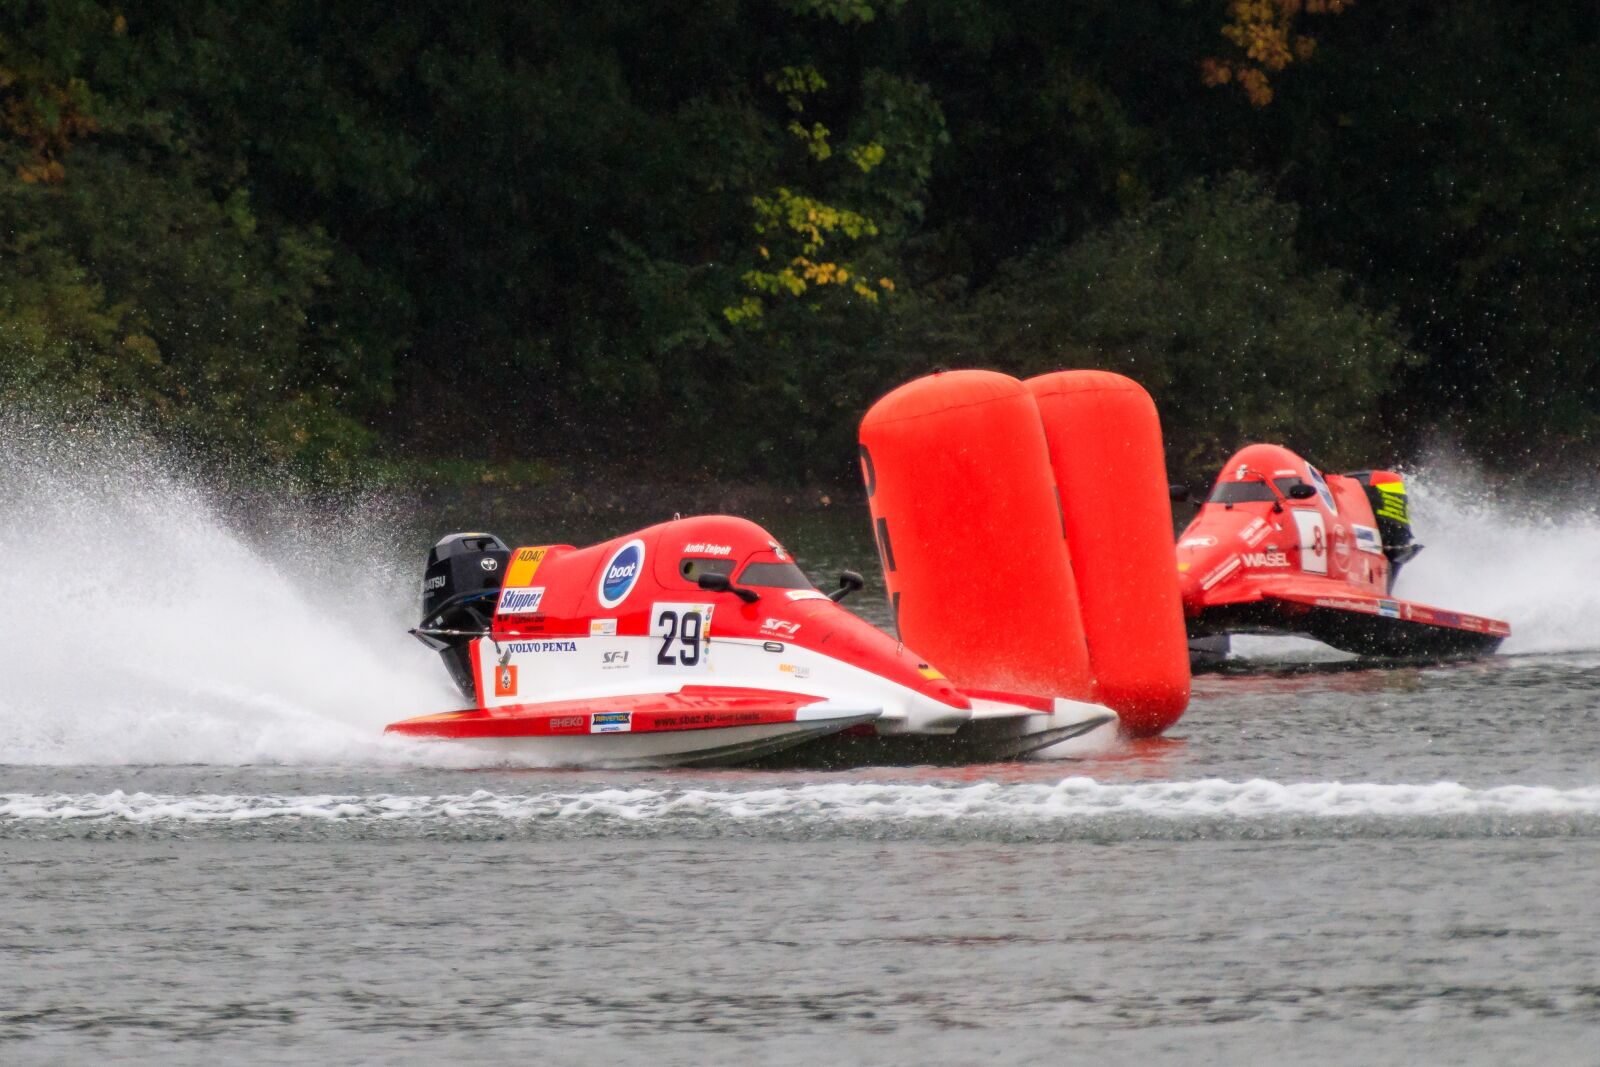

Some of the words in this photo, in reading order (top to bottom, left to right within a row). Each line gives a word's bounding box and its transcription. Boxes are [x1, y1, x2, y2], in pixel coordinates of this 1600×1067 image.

[519, 551, 544, 562] ADAC
[1241, 552, 1291, 568] WASEL
[609, 562, 636, 578] boot
[657, 610, 702, 667] 29
[508, 642, 541, 654] VOLVO
[542, 641, 577, 652] PENTA
